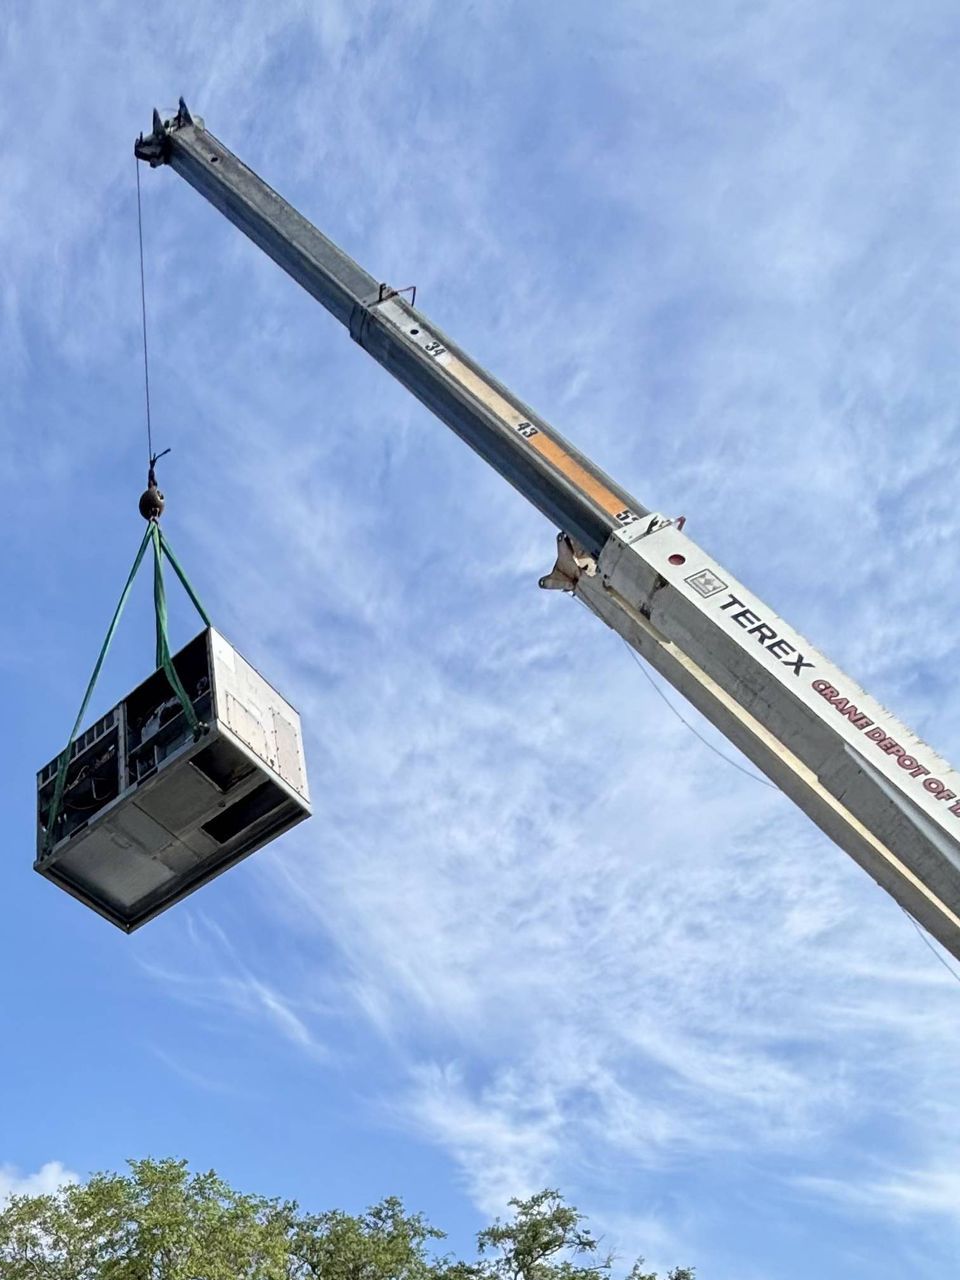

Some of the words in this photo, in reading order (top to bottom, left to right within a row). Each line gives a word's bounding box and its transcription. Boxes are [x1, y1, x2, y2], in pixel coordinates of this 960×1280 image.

[425, 341, 446, 357] 34
[517, 422, 539, 438] 43
[719, 593, 816, 677] TEREX
[811, 679, 875, 731] CRANE
[864, 726, 931, 779] DEPOT
[922, 777, 957, 801] OF
